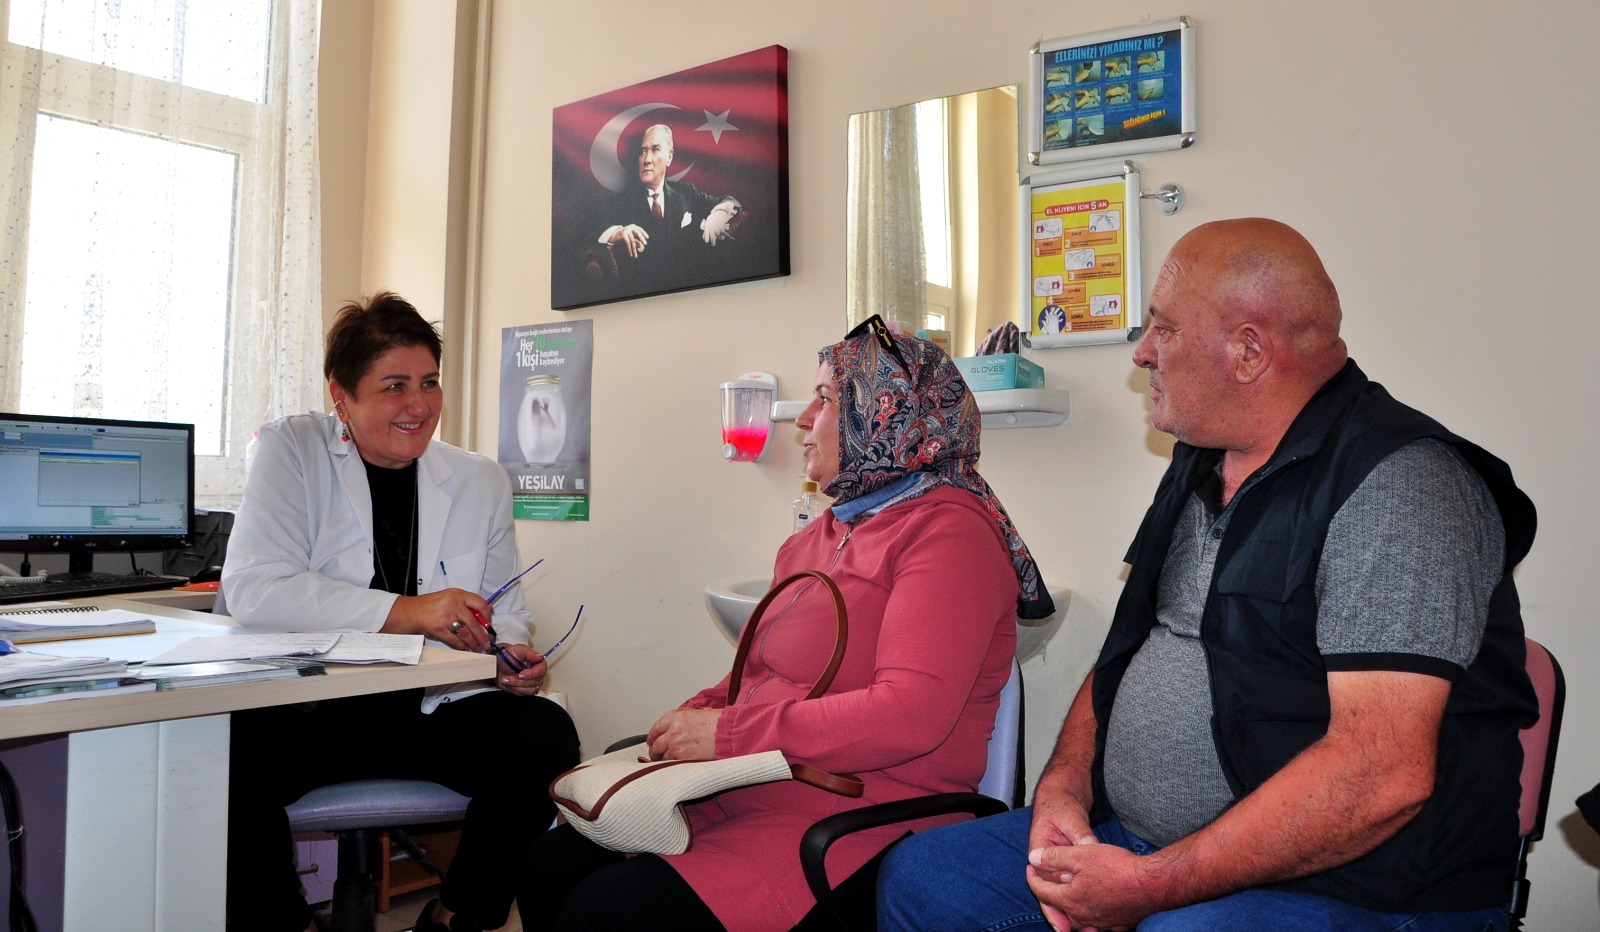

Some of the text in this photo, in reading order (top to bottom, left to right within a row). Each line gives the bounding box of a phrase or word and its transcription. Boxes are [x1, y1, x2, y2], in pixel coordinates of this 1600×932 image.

[1055, 35, 1164, 63] ELLERİNİZİ YIKADINIZ MI ?
[1054, 205, 1076, 214] HİJYENİ
[1077, 203, 1089, 212] İÇİN
[1090, 201, 1097, 210] 5
[1064, 240, 1071, 248] 2
[1035, 247, 1040, 256] 1
[1069, 271, 1075, 280] 3
[1066, 322, 1072, 331] 5
[520, 339, 534, 351] Her
[521, 349, 539, 371] kişi
[970, 364, 1005, 374] GLOVES
[517, 474, 565, 491] YEŞİLAY
